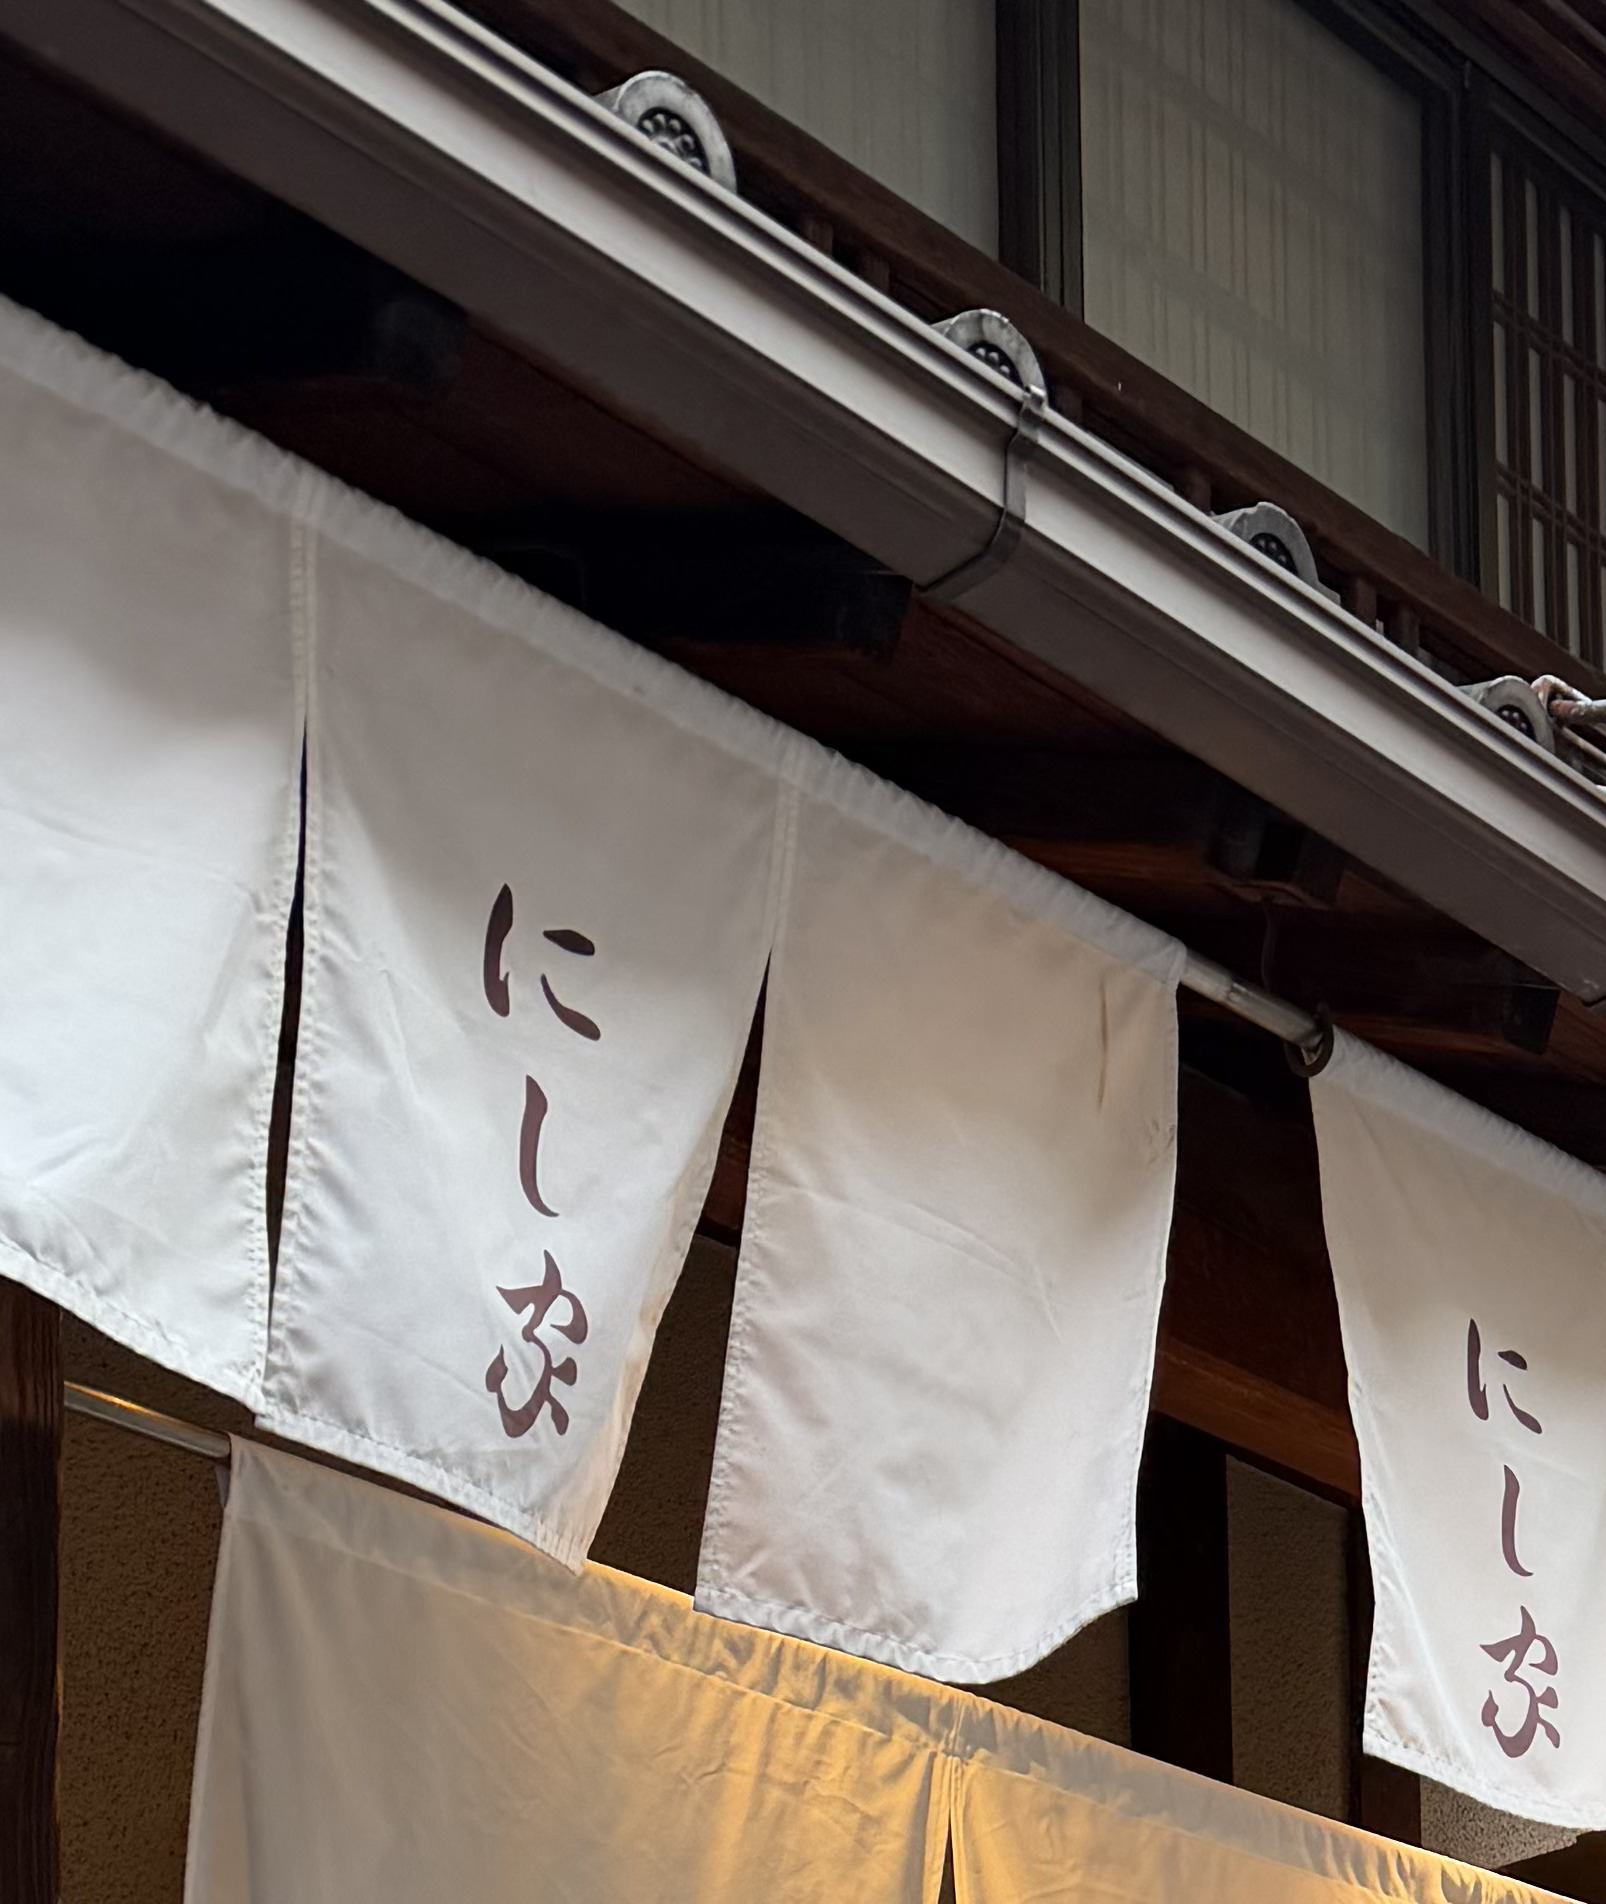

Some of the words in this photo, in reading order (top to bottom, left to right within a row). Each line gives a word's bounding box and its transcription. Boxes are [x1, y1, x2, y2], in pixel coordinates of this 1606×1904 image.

[483, 883, 601, 1438] にし家
[1467, 1318, 1560, 1758] にし家
